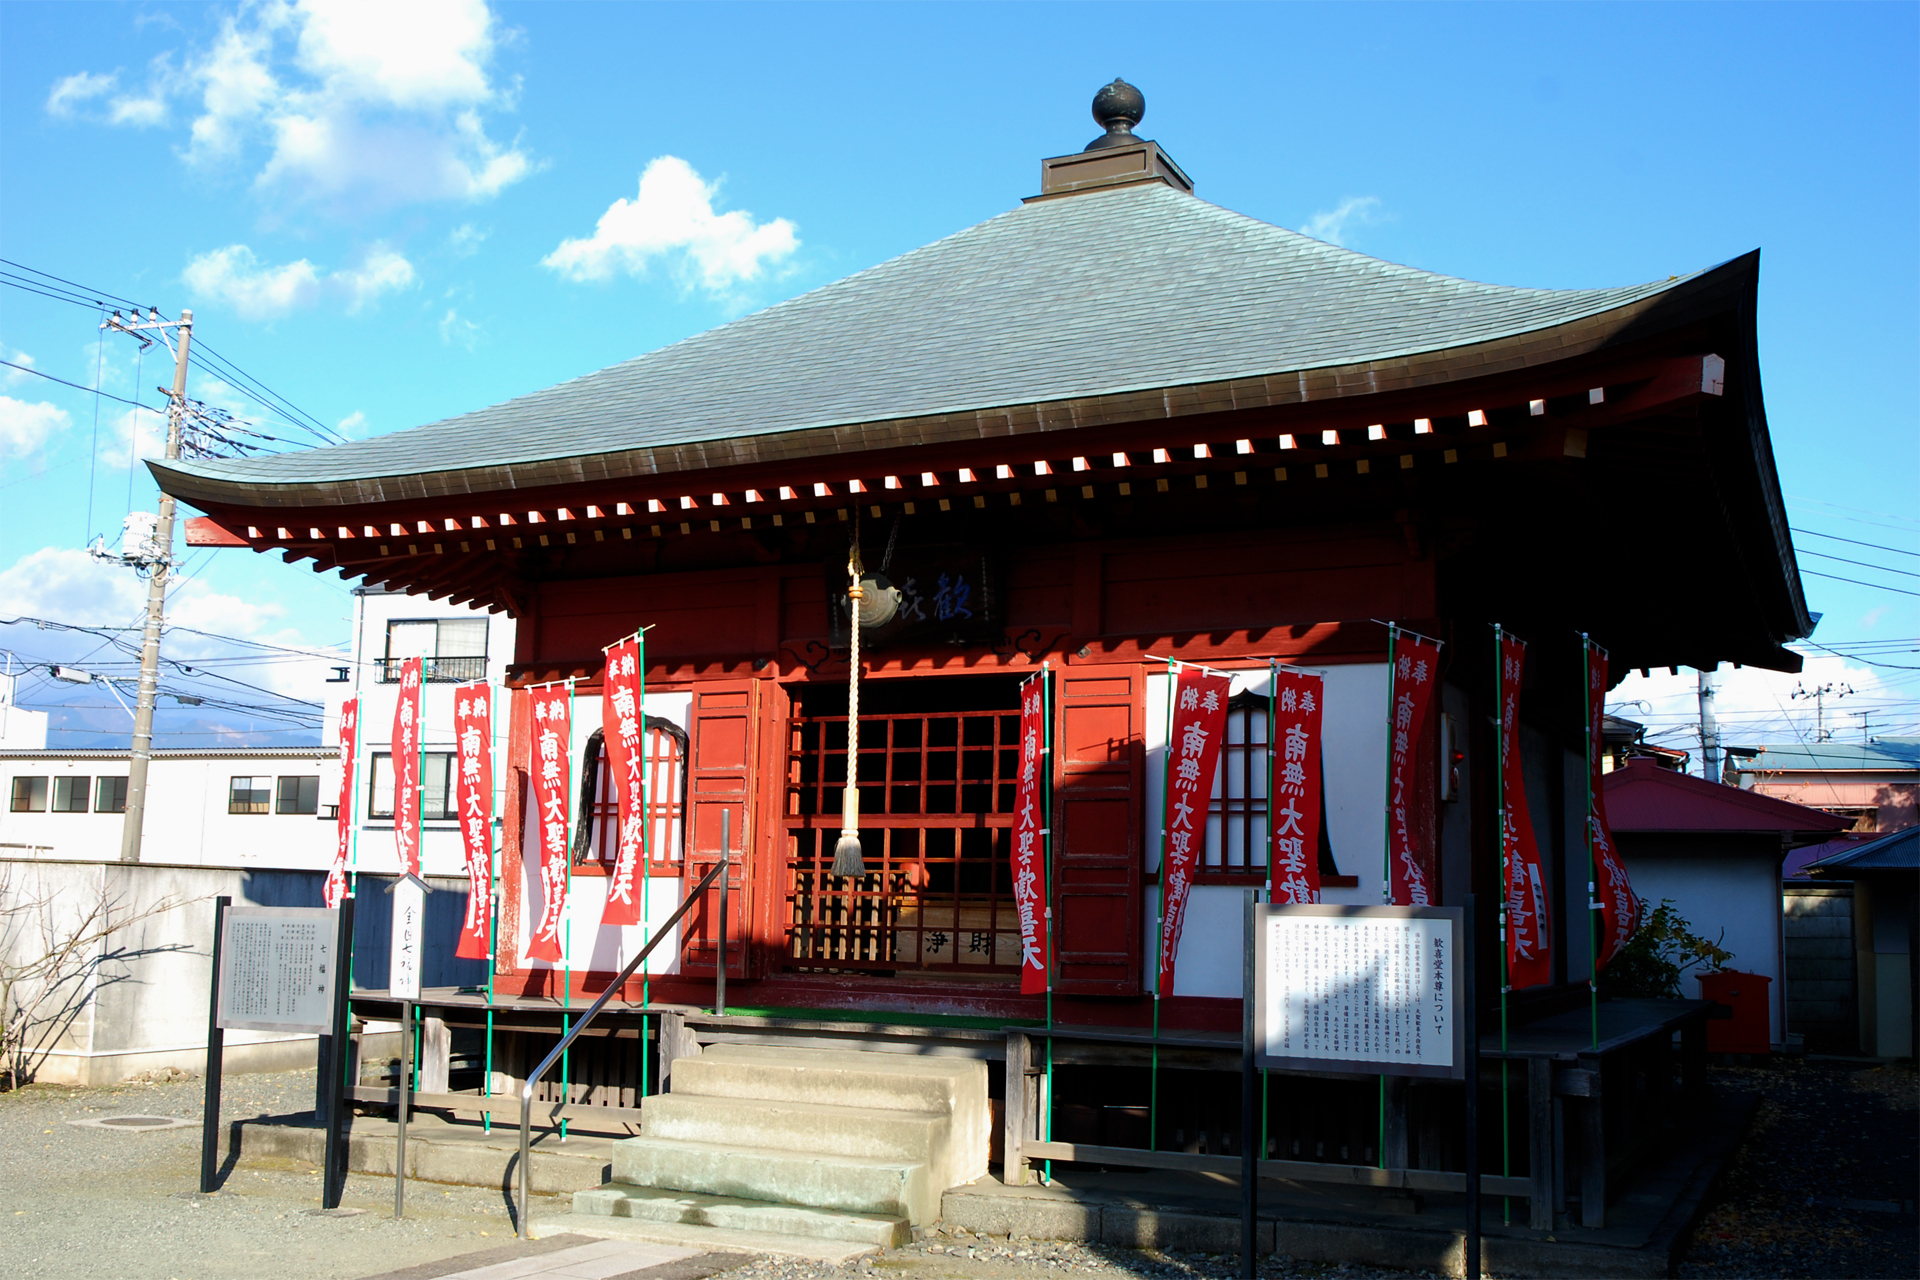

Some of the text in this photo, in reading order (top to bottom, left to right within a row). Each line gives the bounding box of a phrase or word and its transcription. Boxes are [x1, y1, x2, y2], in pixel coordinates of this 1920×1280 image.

[608, 653, 636, 681] 奉納
[457, 696, 488, 721] 奉納
[535, 698, 565, 722] 奉納
[1024, 691, 1041, 718] 奉納
[317, 944, 327, 995] 七福神
[1433, 937, 1444, 1035] 歓喜堂本尊について
